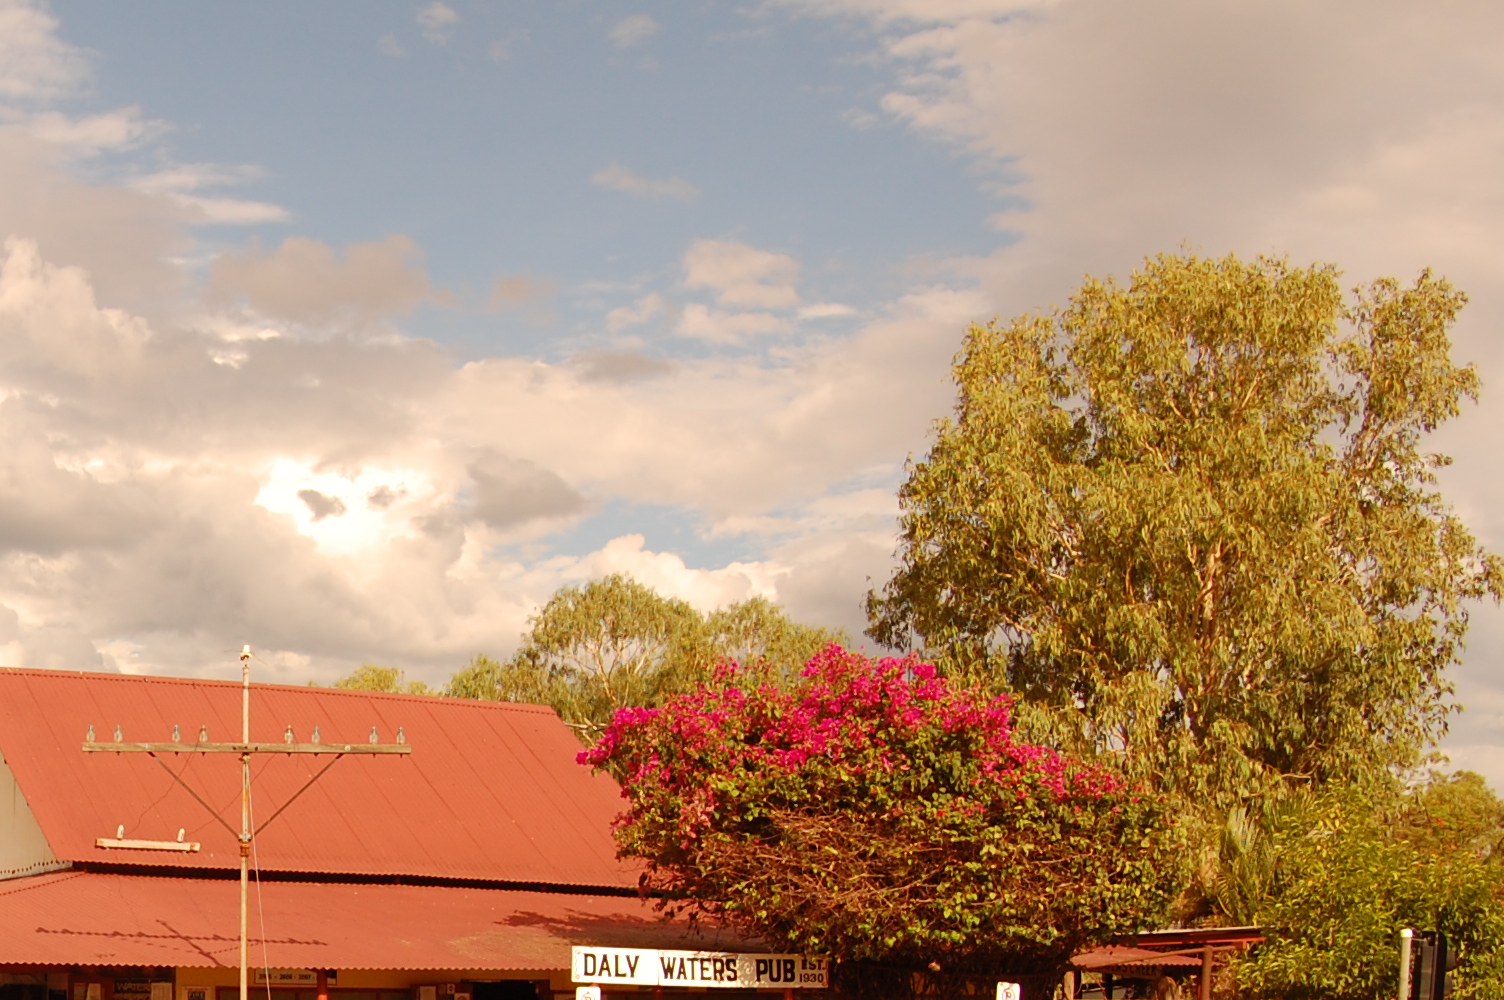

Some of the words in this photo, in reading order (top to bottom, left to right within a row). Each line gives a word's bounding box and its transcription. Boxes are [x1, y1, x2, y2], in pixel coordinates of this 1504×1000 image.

[583, 953, 639, 978] DALY
[659, 956, 738, 982] WATERS
[755, 958, 796, 983] PUB
[801, 957, 826, 970] EST.
[799, 972, 824, 983] 1930
